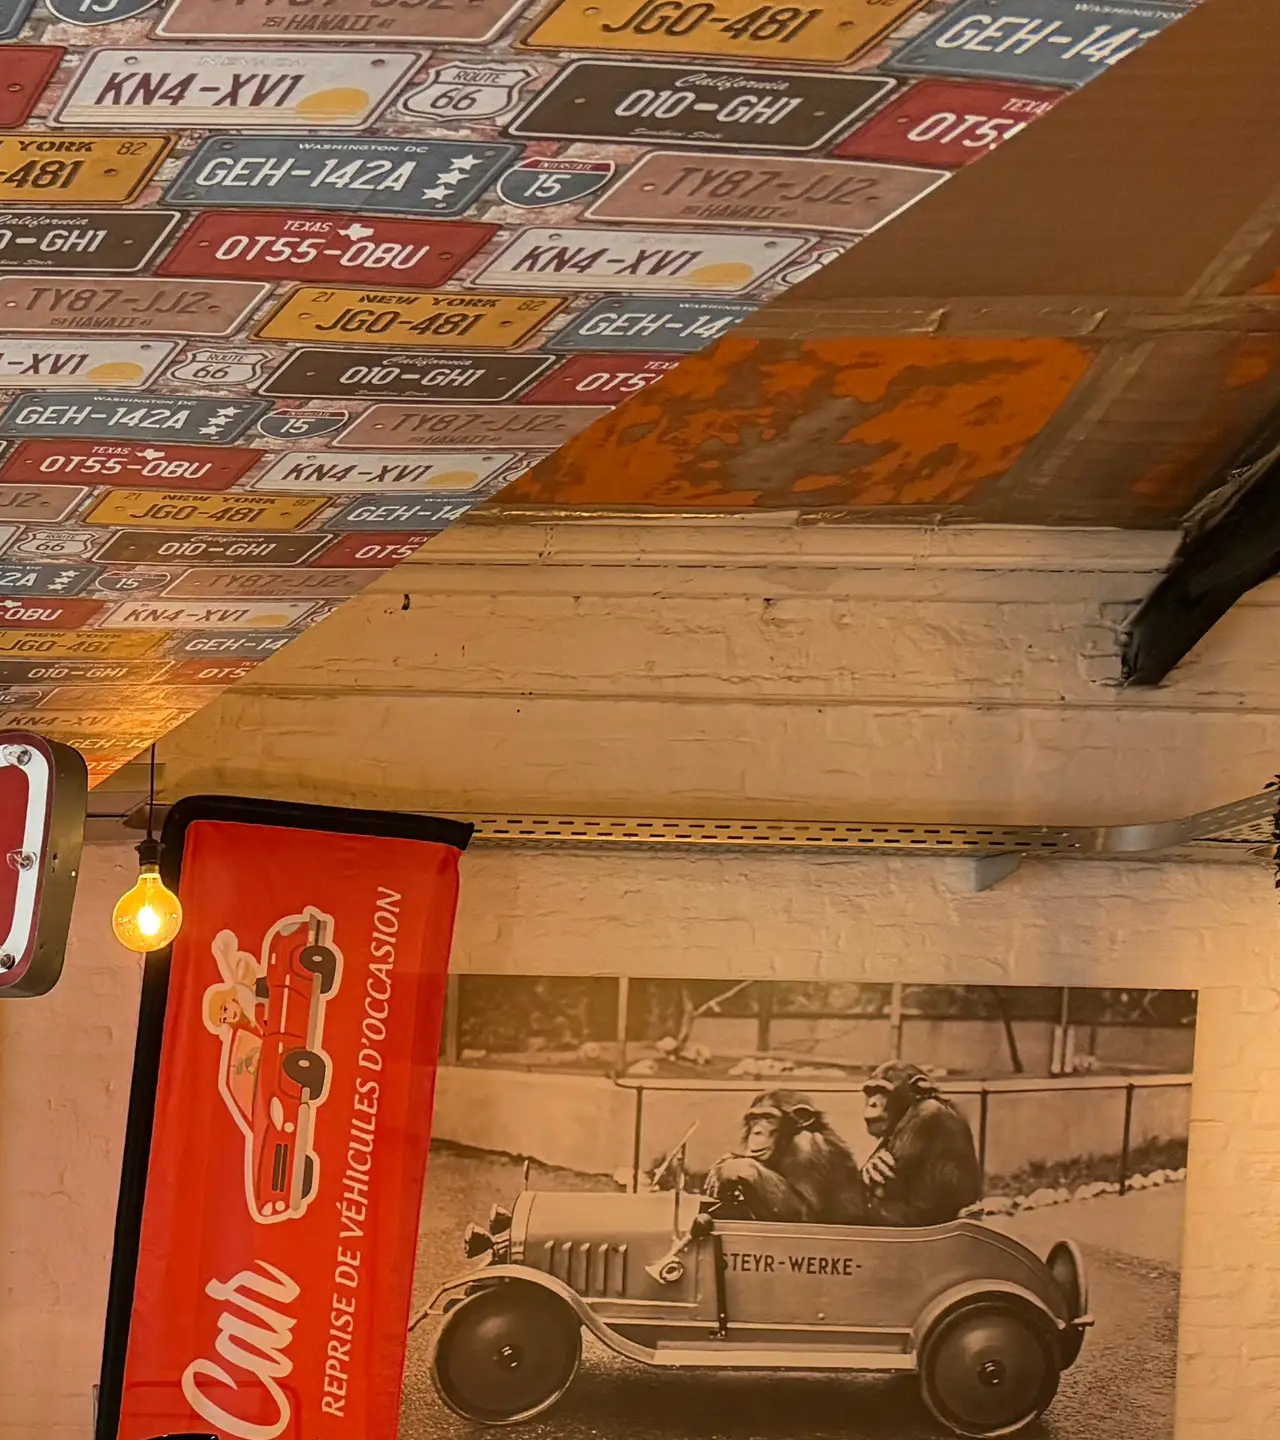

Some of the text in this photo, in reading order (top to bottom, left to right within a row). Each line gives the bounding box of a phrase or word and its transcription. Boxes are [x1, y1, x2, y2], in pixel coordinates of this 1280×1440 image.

[449, 69, 507, 83] ROUTE
[428, 87, 481, 112] 66
[12, 140, 98, 153] YORK
[114, 144, 149, 158] 82
[192, 156, 412, 191] GEH-142A
[519, 174, 575, 197] 15
[278, 221, 335, 233] TEXAS
[336, 1077, 380, 1239] VÉHICULES
[335, 1245, 361, 1288] DE
[322, 1293, 356, 1418] REPRISE
